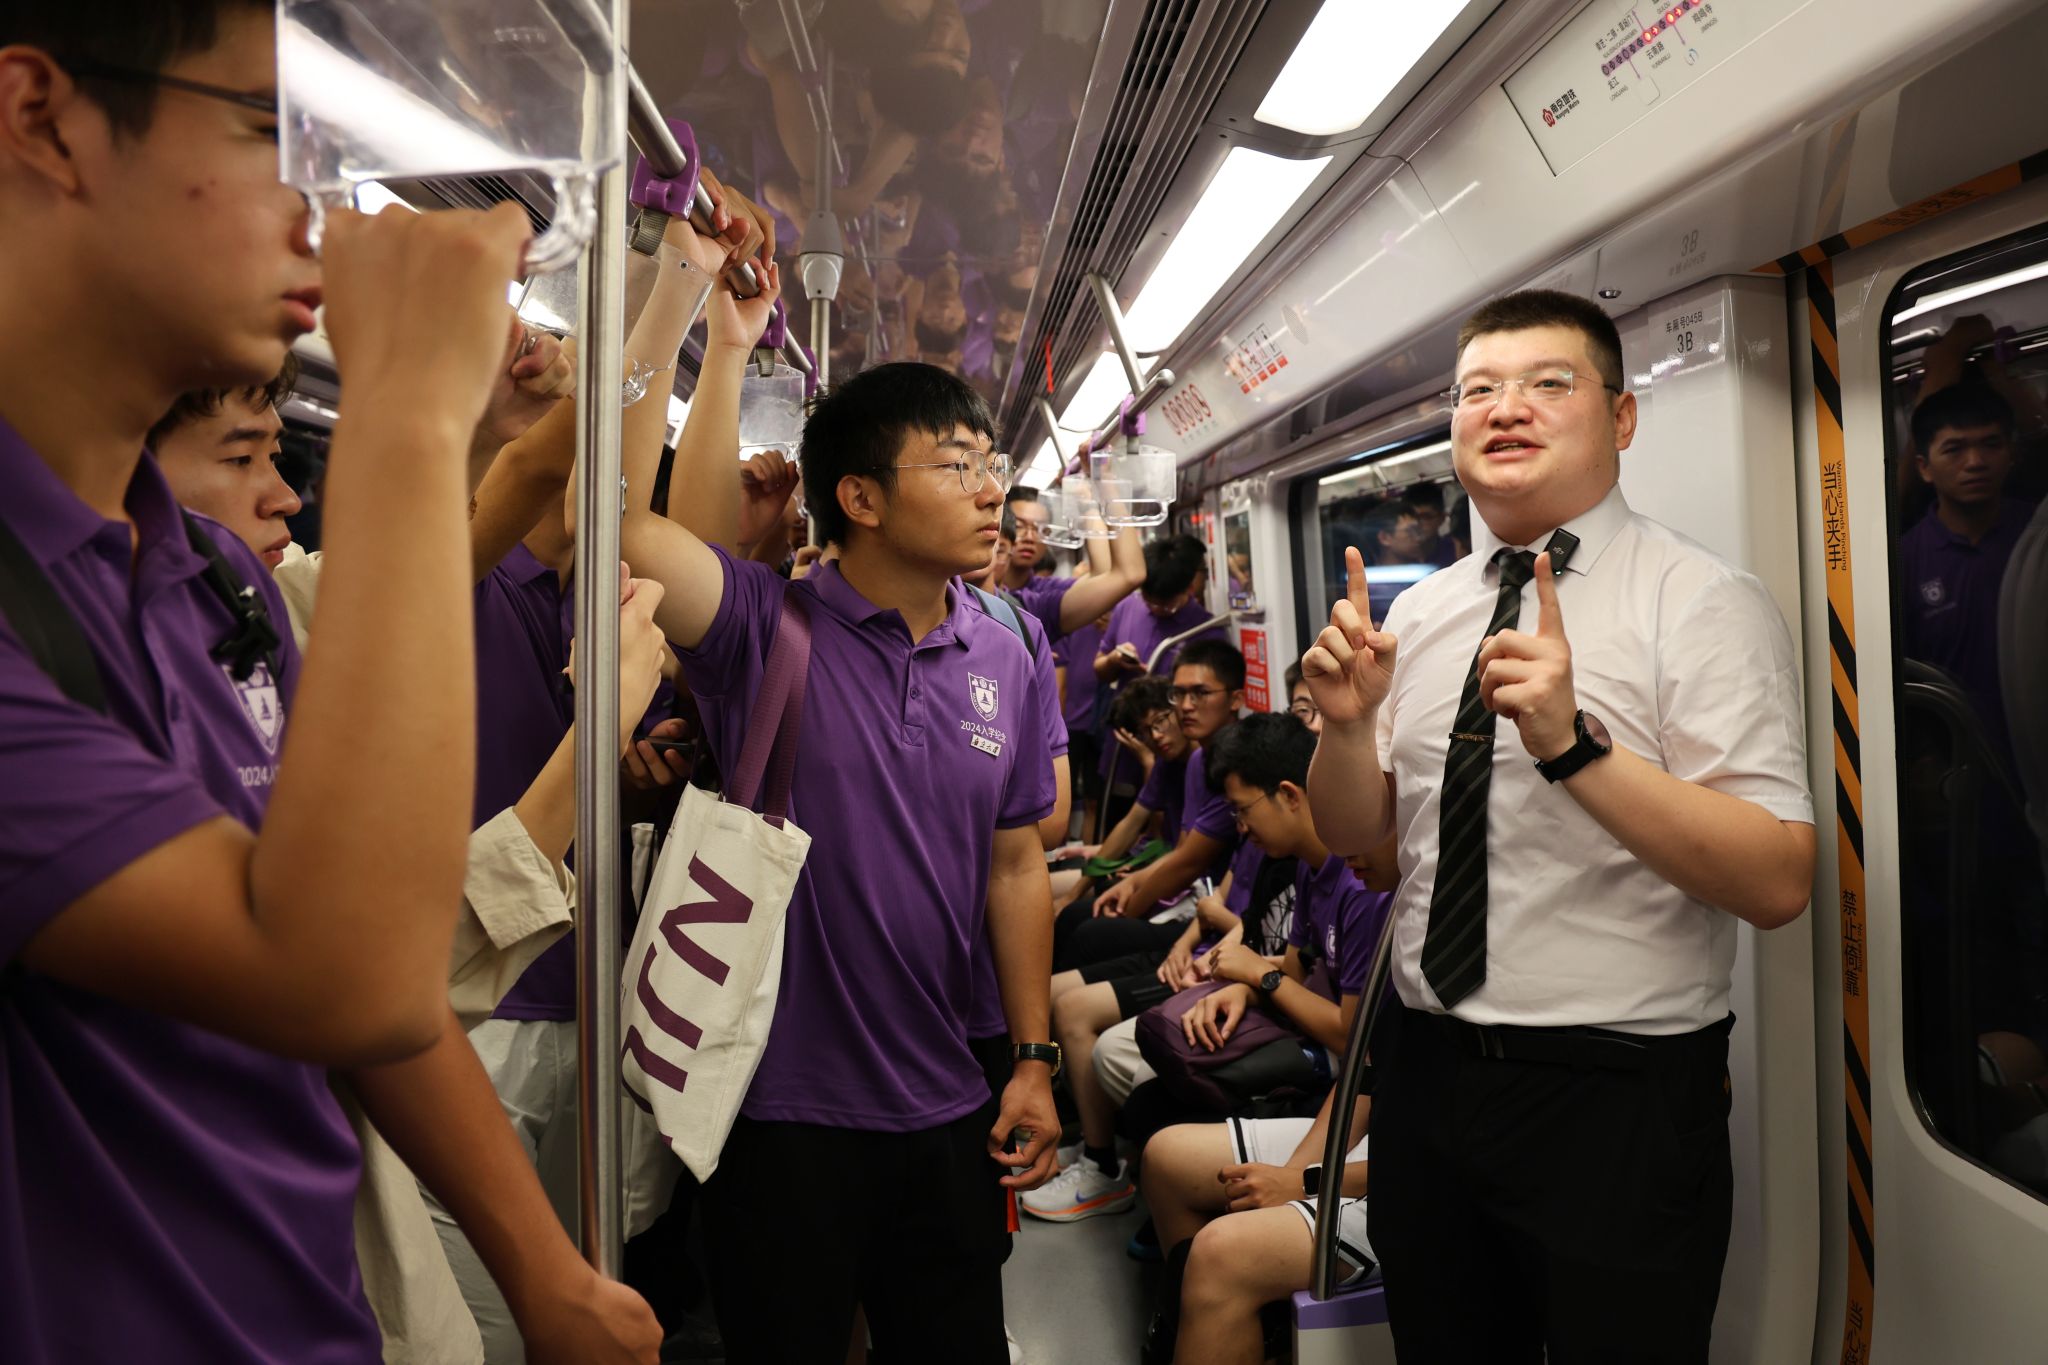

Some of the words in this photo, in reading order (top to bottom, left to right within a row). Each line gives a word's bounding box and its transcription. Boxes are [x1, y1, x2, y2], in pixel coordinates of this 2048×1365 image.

[1549, 88, 1577, 114] 南京地铁
[1676, 331, 1694, 354] 3B
[1824, 463, 1842, 570] 当心夹手
[960, 720, 1006, 744] 2024入学纪念
[237, 765, 280, 787] 2024入
[1843, 889, 1860, 998] 禁止倚靠
